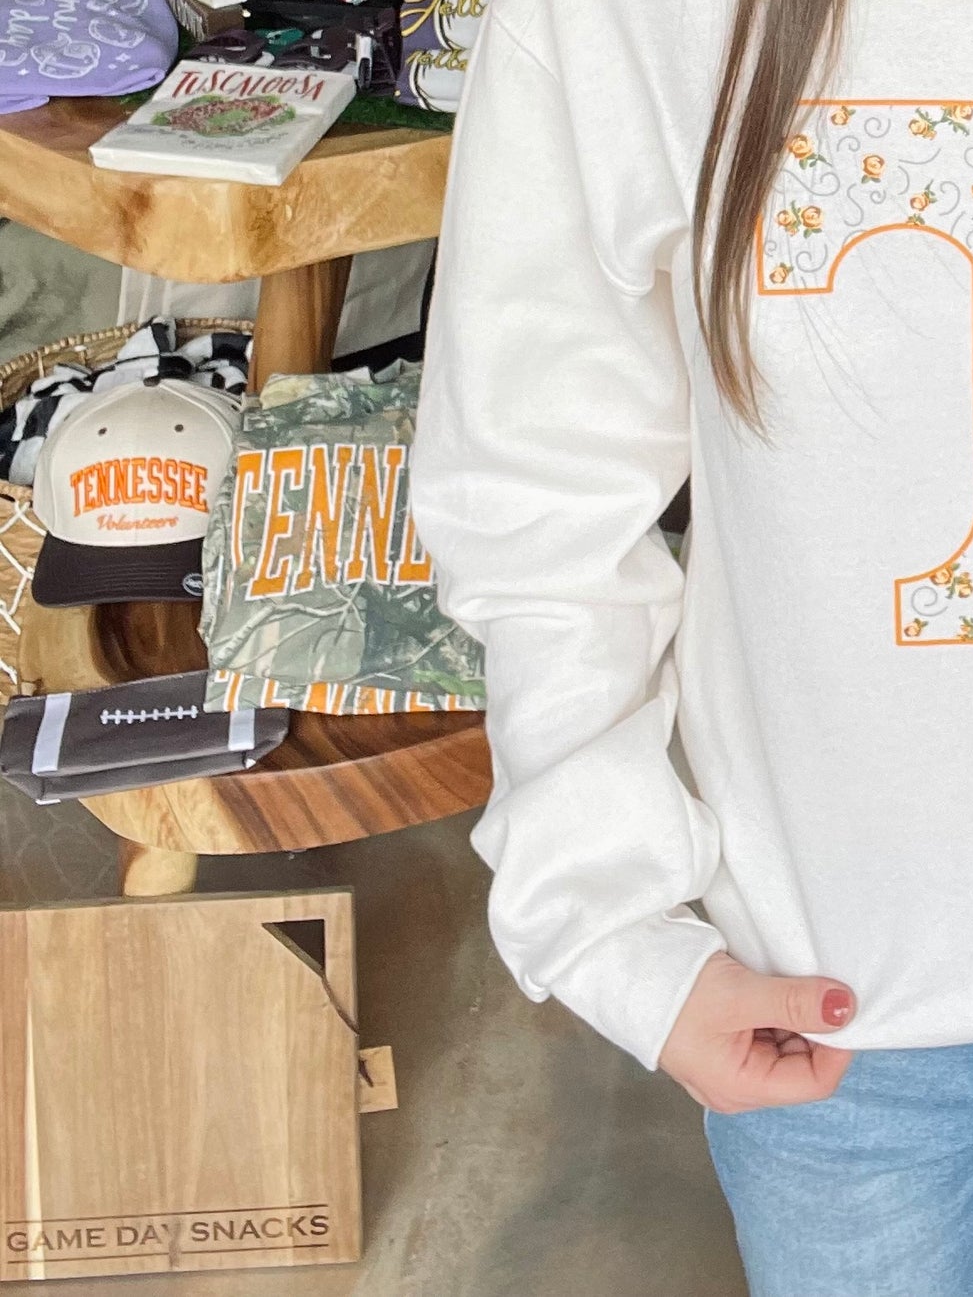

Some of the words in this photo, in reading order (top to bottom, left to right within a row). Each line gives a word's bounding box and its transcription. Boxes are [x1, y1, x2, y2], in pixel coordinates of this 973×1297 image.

[171, 69, 327, 101] TUSCALOOSA
[69, 456, 211, 518] TENNESSEE
[96, 512, 180, 531] Volunteers
[7, 1228, 106, 1253] GAME
[115, 1221, 182, 1247] DAY
[191, 1214, 330, 1243] SNACKS
